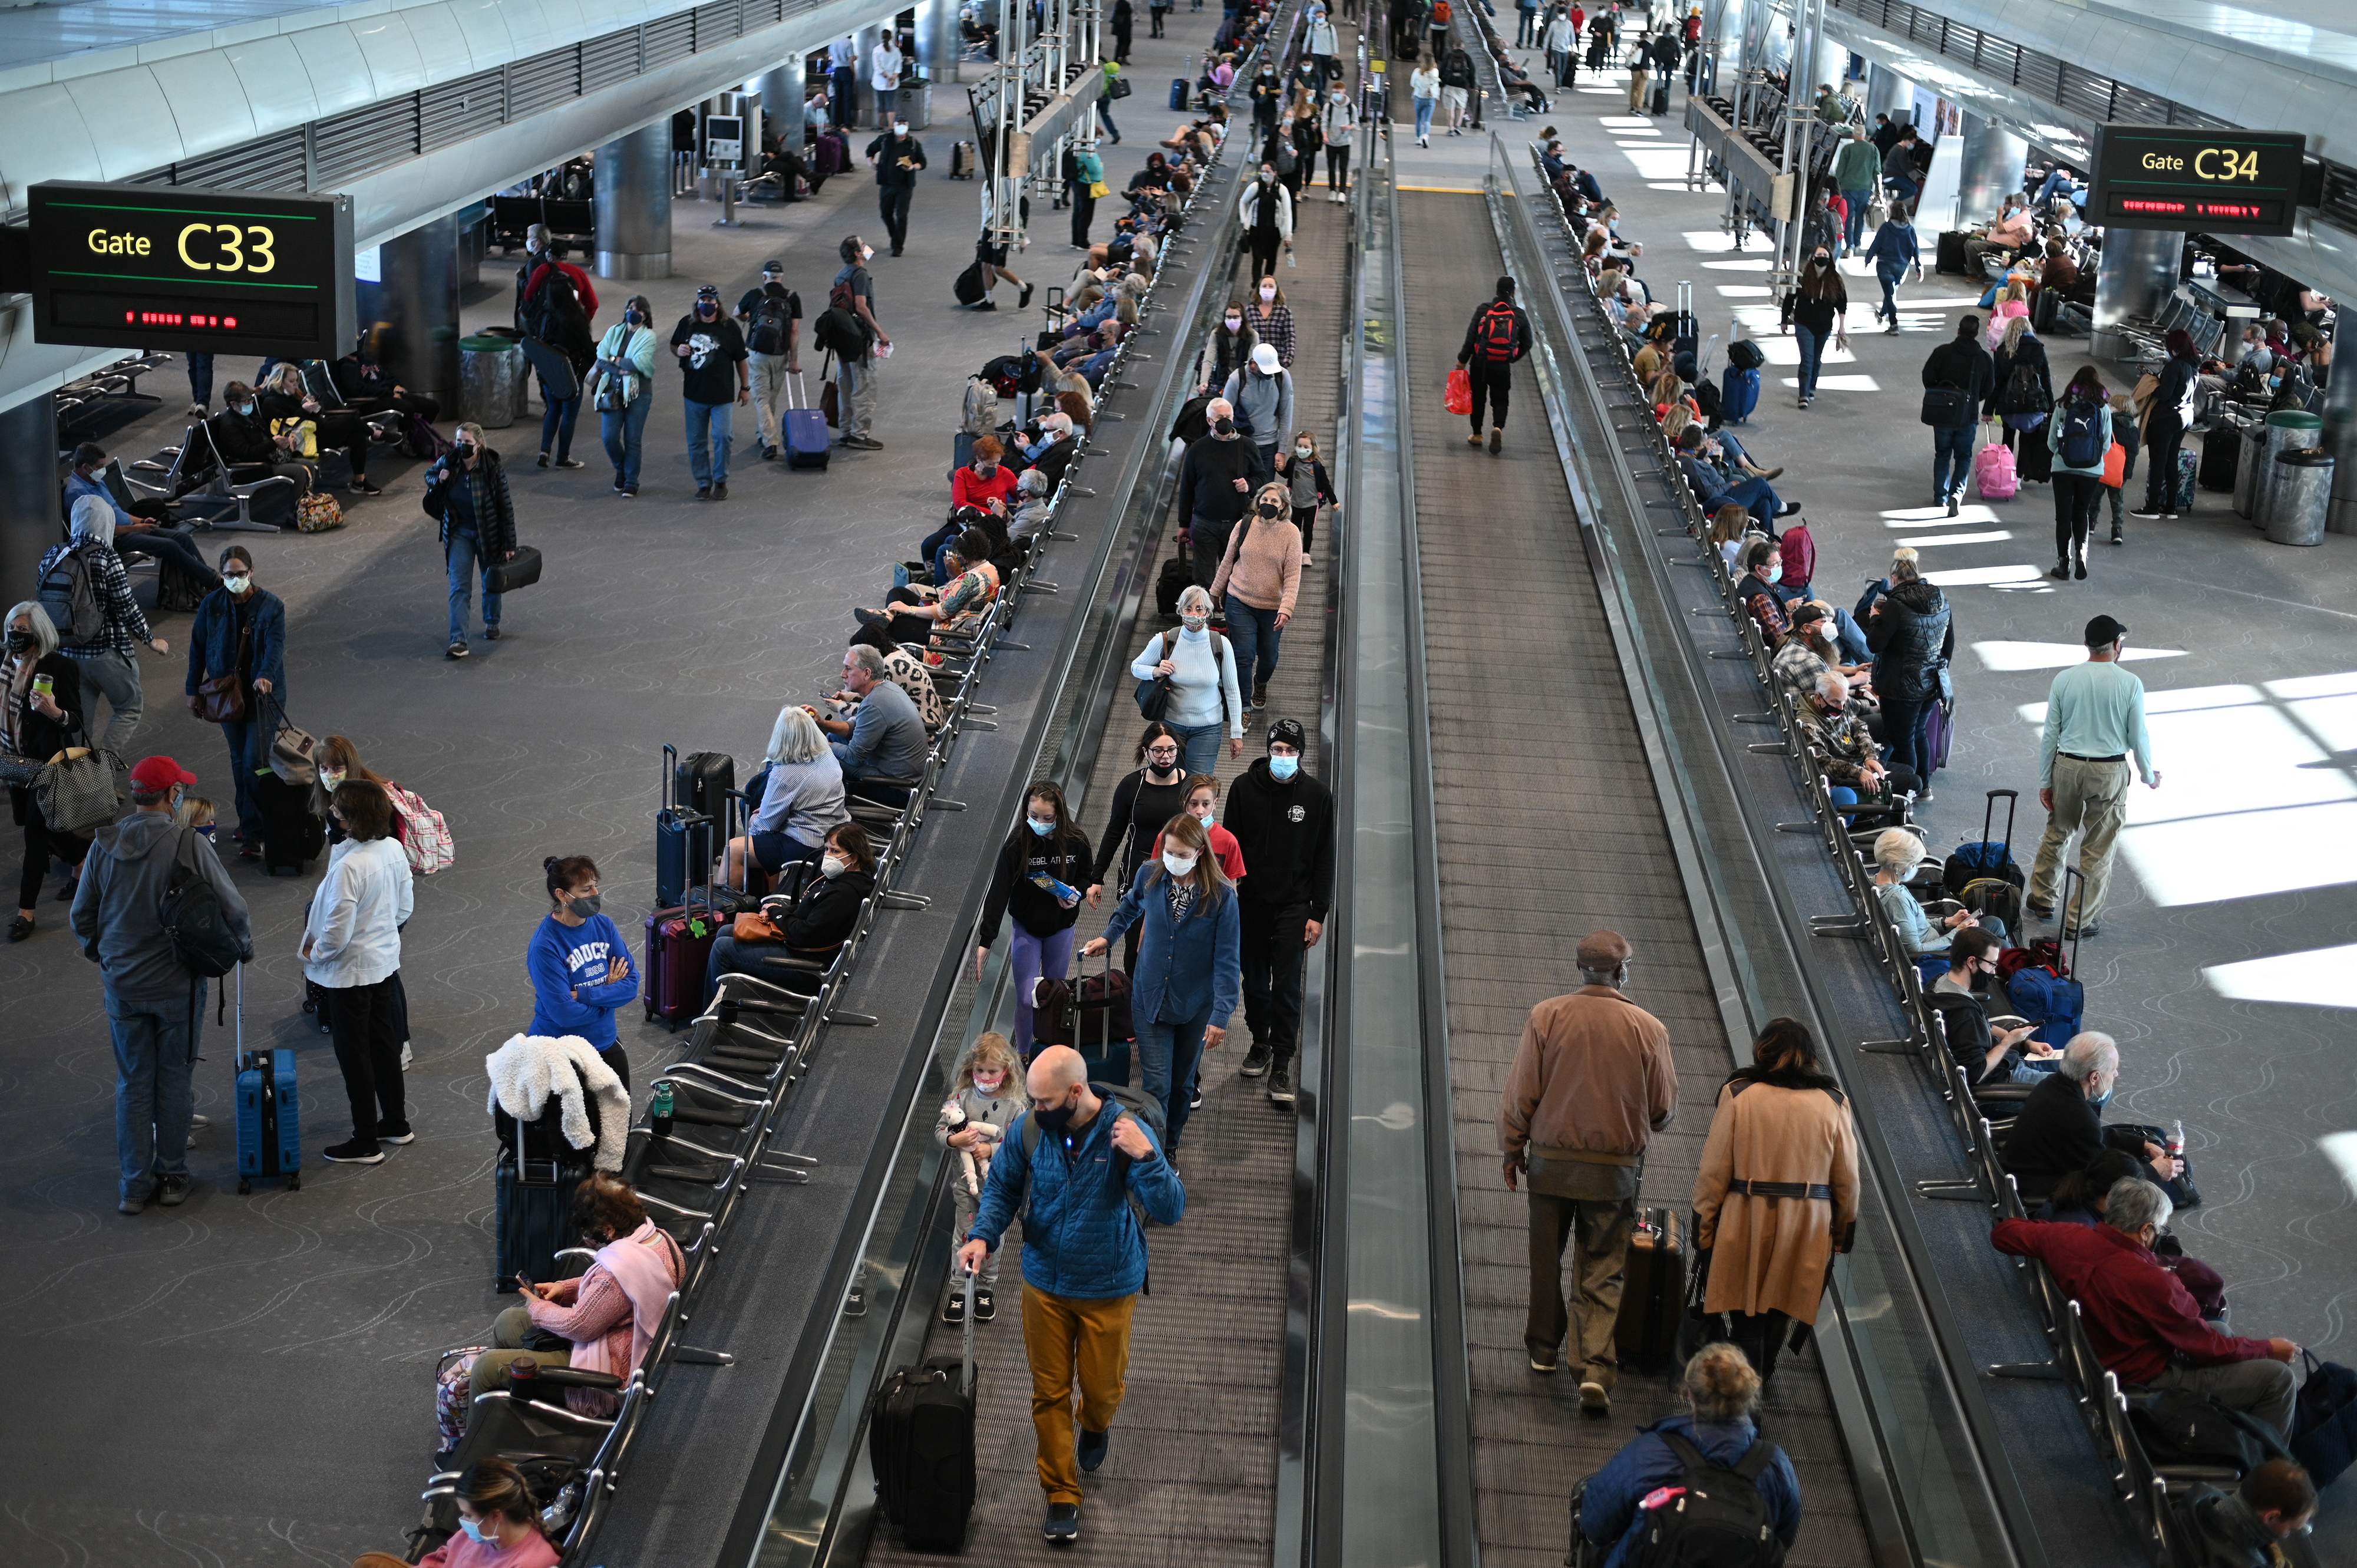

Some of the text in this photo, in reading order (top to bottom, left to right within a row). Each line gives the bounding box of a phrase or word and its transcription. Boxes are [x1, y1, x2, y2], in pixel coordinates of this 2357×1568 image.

[2142, 148, 2259, 181] Gate C34
[88, 223, 275, 273] Gate C33
[1028, 857, 1048, 866] REBEL
[585, 963, 605, 978] 1999
